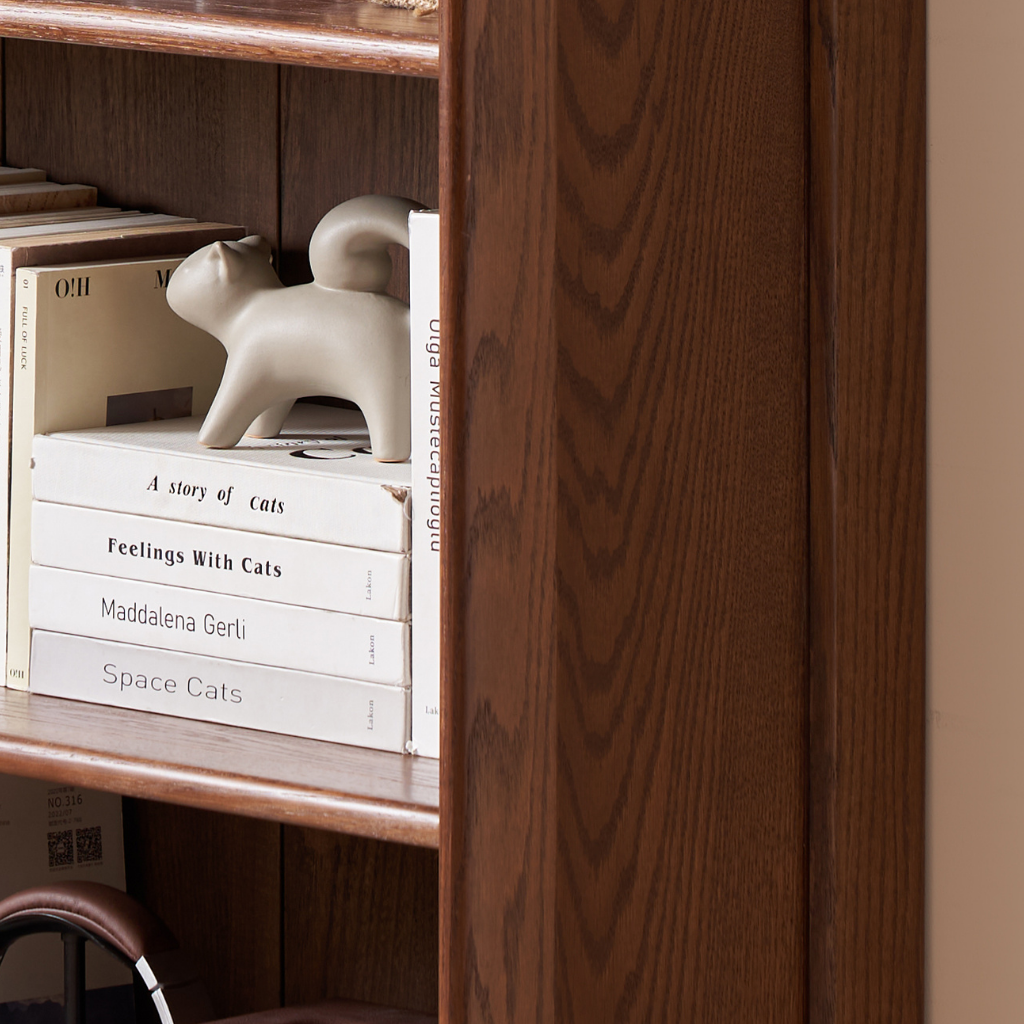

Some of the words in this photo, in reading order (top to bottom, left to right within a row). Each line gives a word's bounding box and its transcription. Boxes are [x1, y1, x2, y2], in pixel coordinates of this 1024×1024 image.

[55, 276, 91, 299] O!H
[21, 331, 28, 342] OF
[20, 345, 28, 370] LUCK
[147, 475, 159, 492] A
[169, 477, 208, 502] story
[217, 485, 235, 506] of
[108, 536, 185, 567] Feelings
[193, 549, 234, 571] With
[241, 556, 283, 578] Cats
[365, 569, 373, 601] Lakon
[101, 596, 197, 633] Maddalena
[203, 612, 246, 641] Gerli
[102, 663, 177, 695] Space
[187, 677, 244, 705] Cats
[47, 794, 83, 808] NO.316
[48, 809, 73, 818] 2022/07
